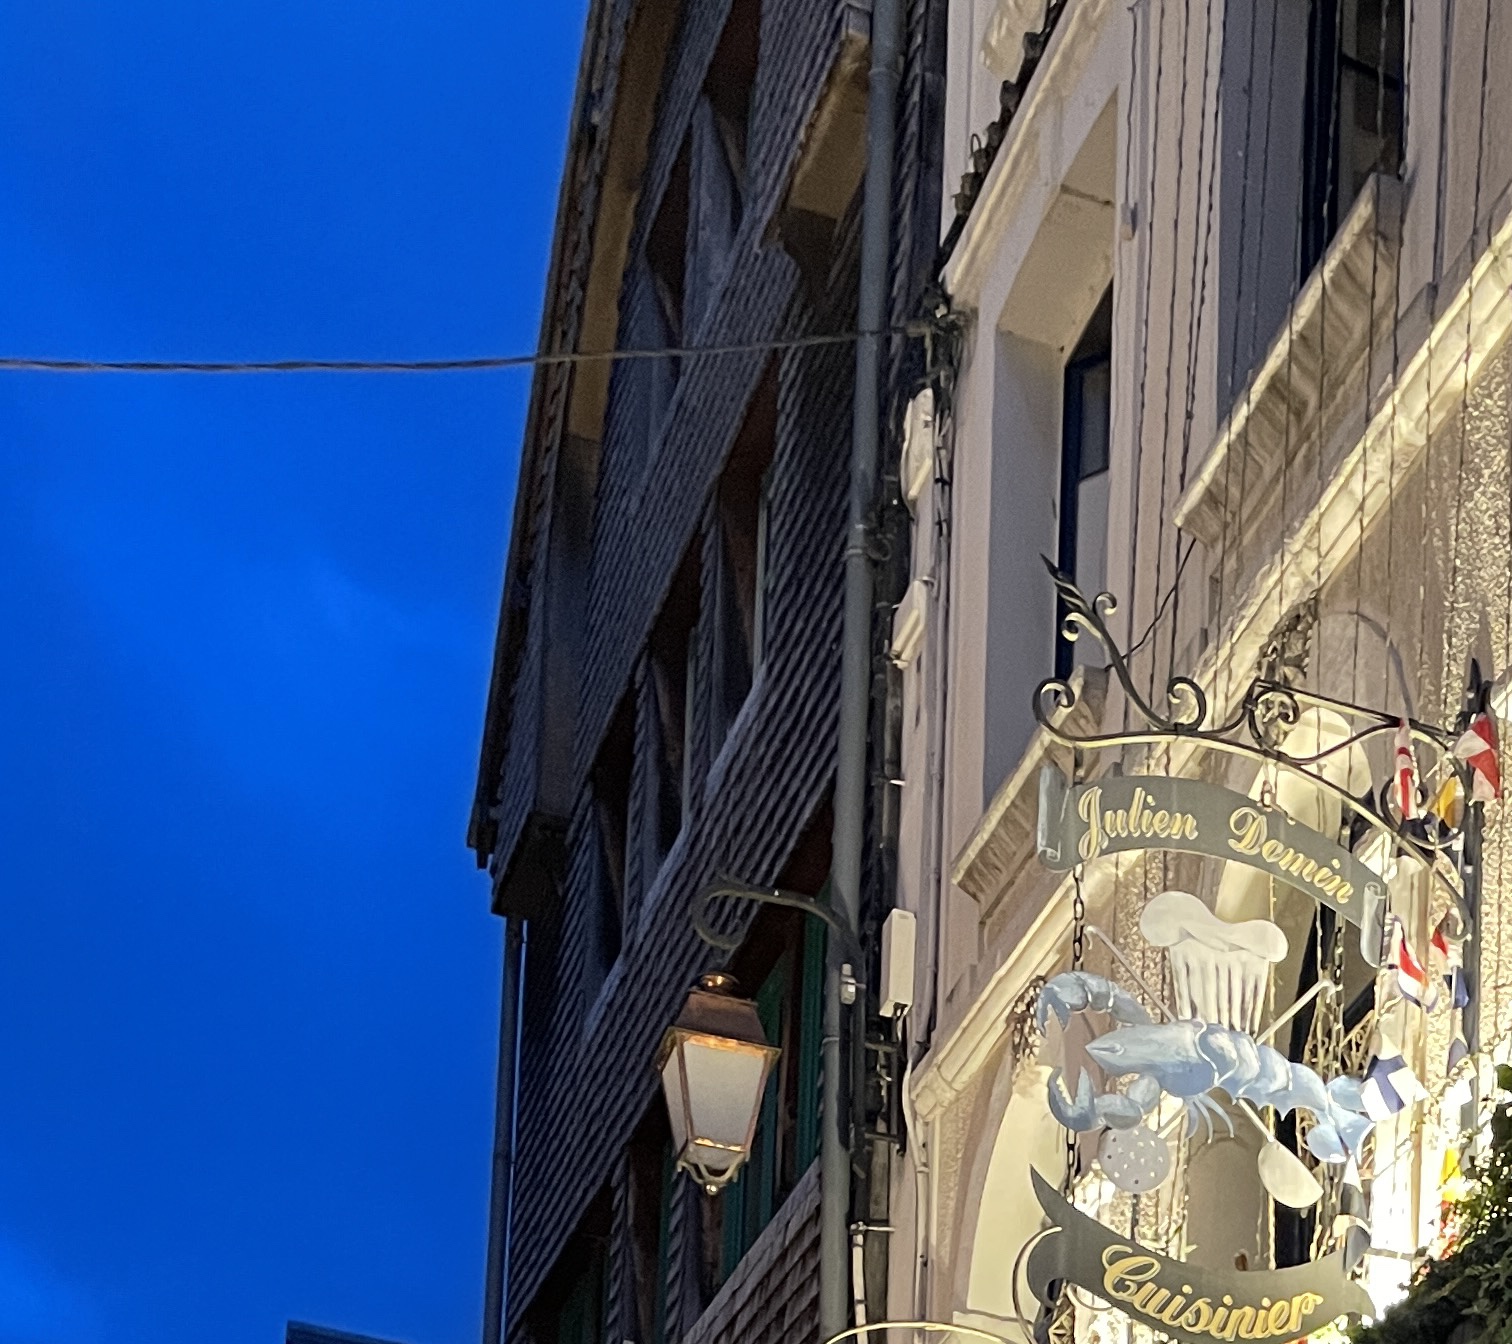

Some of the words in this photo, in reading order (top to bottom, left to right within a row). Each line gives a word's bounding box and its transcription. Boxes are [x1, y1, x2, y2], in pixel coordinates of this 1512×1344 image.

[1078, 783, 1199, 861] Julien
[1228, 806, 1354, 904] Domin
[1102, 1244, 1324, 1342] Cuisinier
